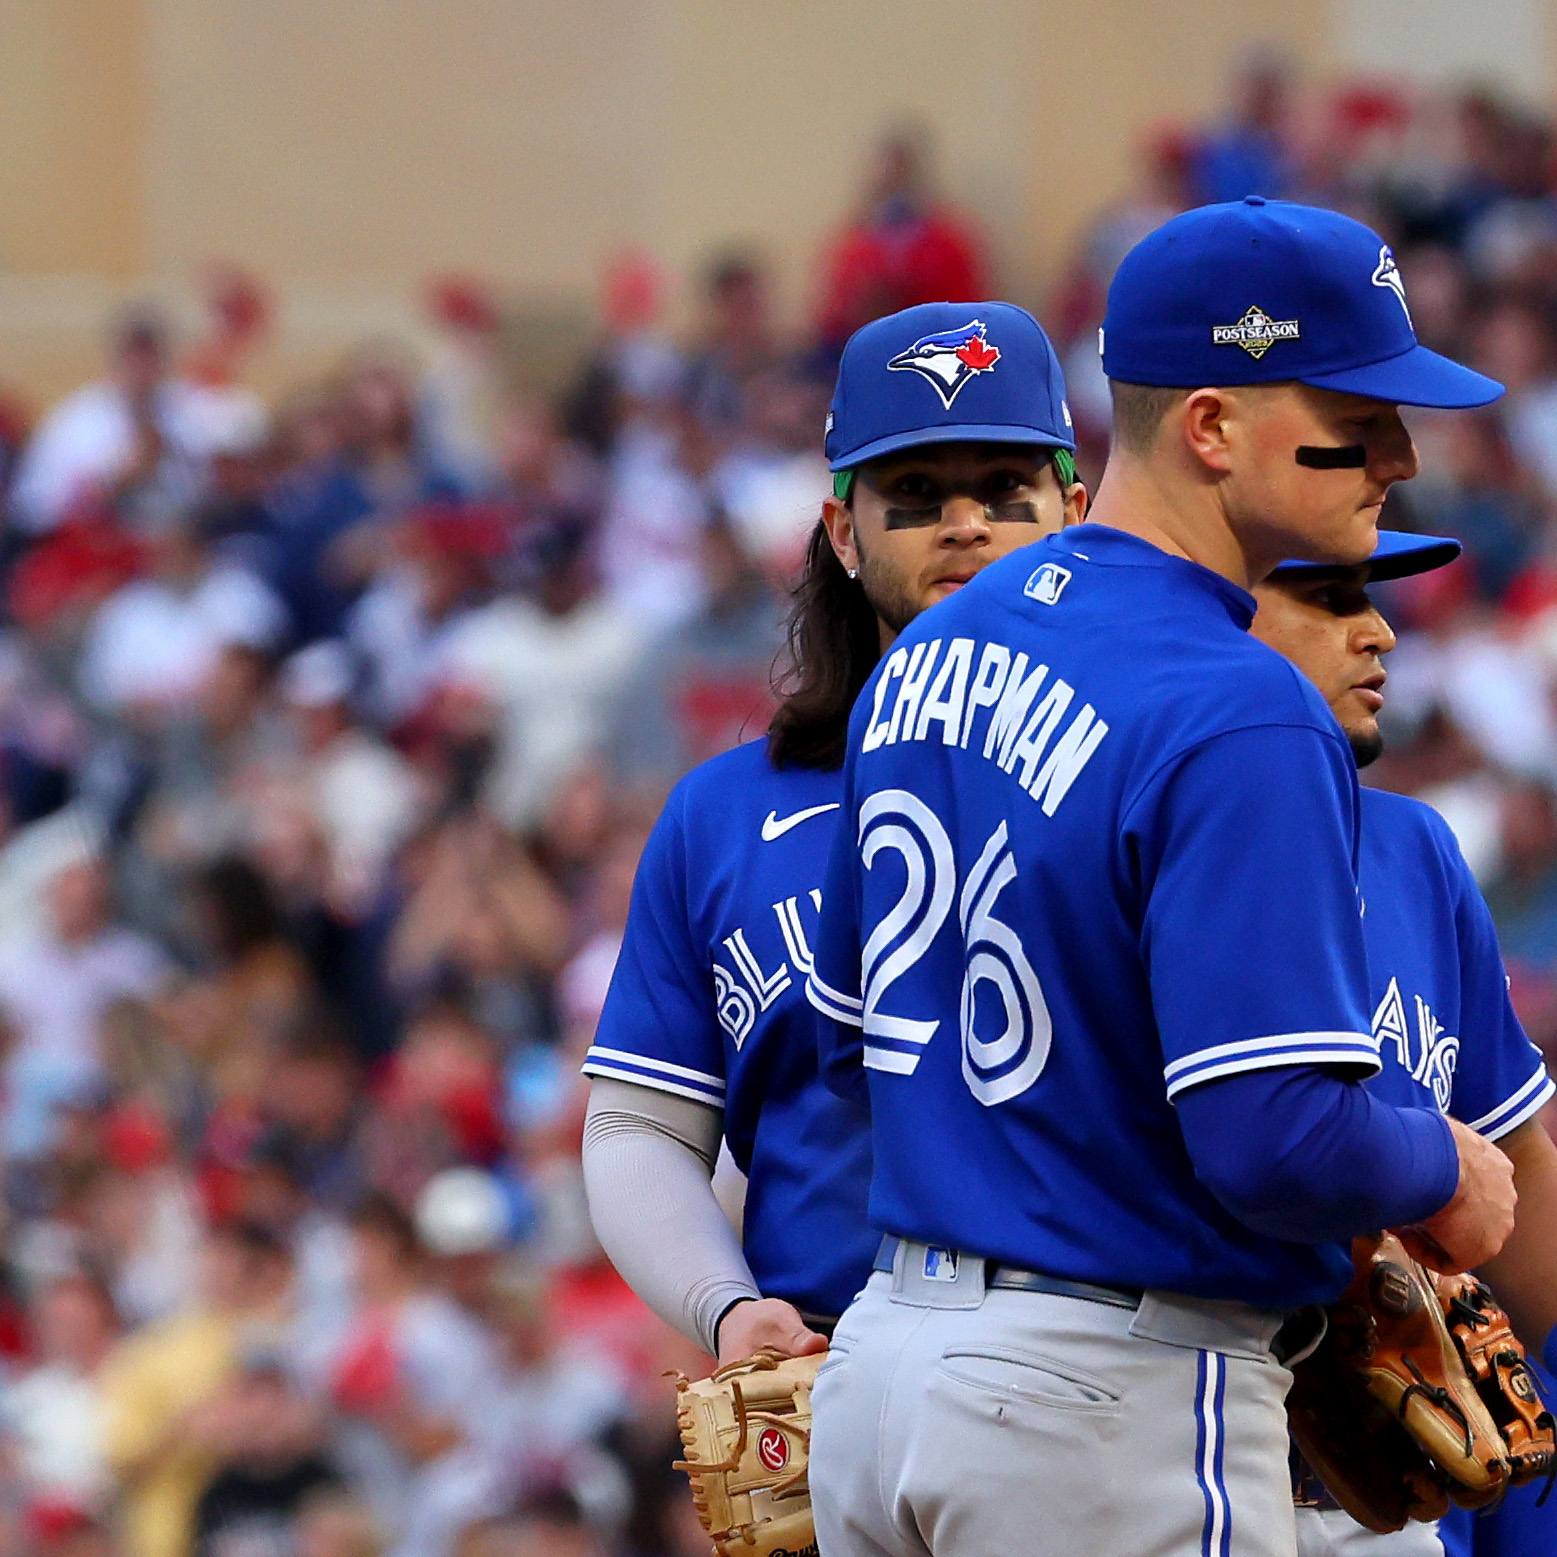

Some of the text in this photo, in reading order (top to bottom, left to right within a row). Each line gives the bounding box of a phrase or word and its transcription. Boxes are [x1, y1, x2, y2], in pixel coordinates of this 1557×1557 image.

[1213, 323, 1299, 341] POSTSEASON
[861, 636, 1110, 818] CHAPMAN
[712, 888, 823, 1053] BLU
[857, 789, 1052, 1108] 26
[1371, 976, 1460, 1115] AYS
